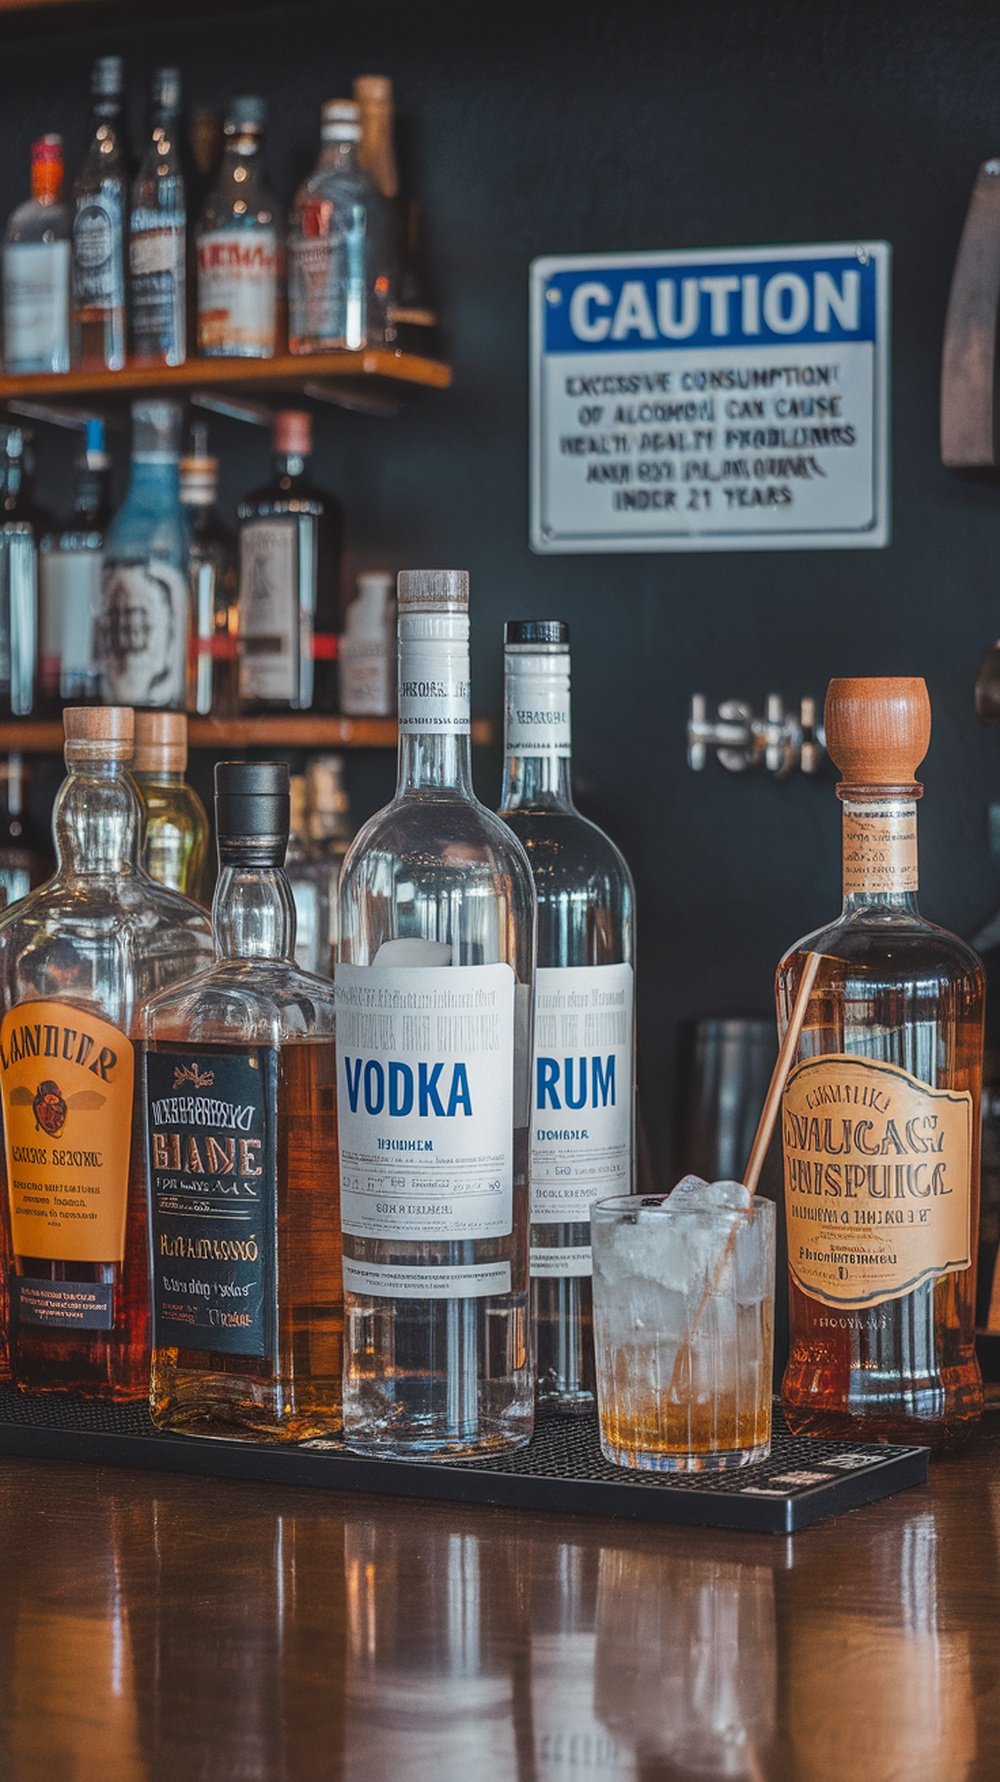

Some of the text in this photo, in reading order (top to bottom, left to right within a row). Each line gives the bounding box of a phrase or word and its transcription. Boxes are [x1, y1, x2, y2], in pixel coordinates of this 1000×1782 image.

[569, 270, 861, 342] CAUTION
[774, 396, 843, 418] CAUSE
[686, 487, 712, 511] 21
[344, 1056, 473, 1117] VODKA
[535, 1054, 616, 1110] RUM
